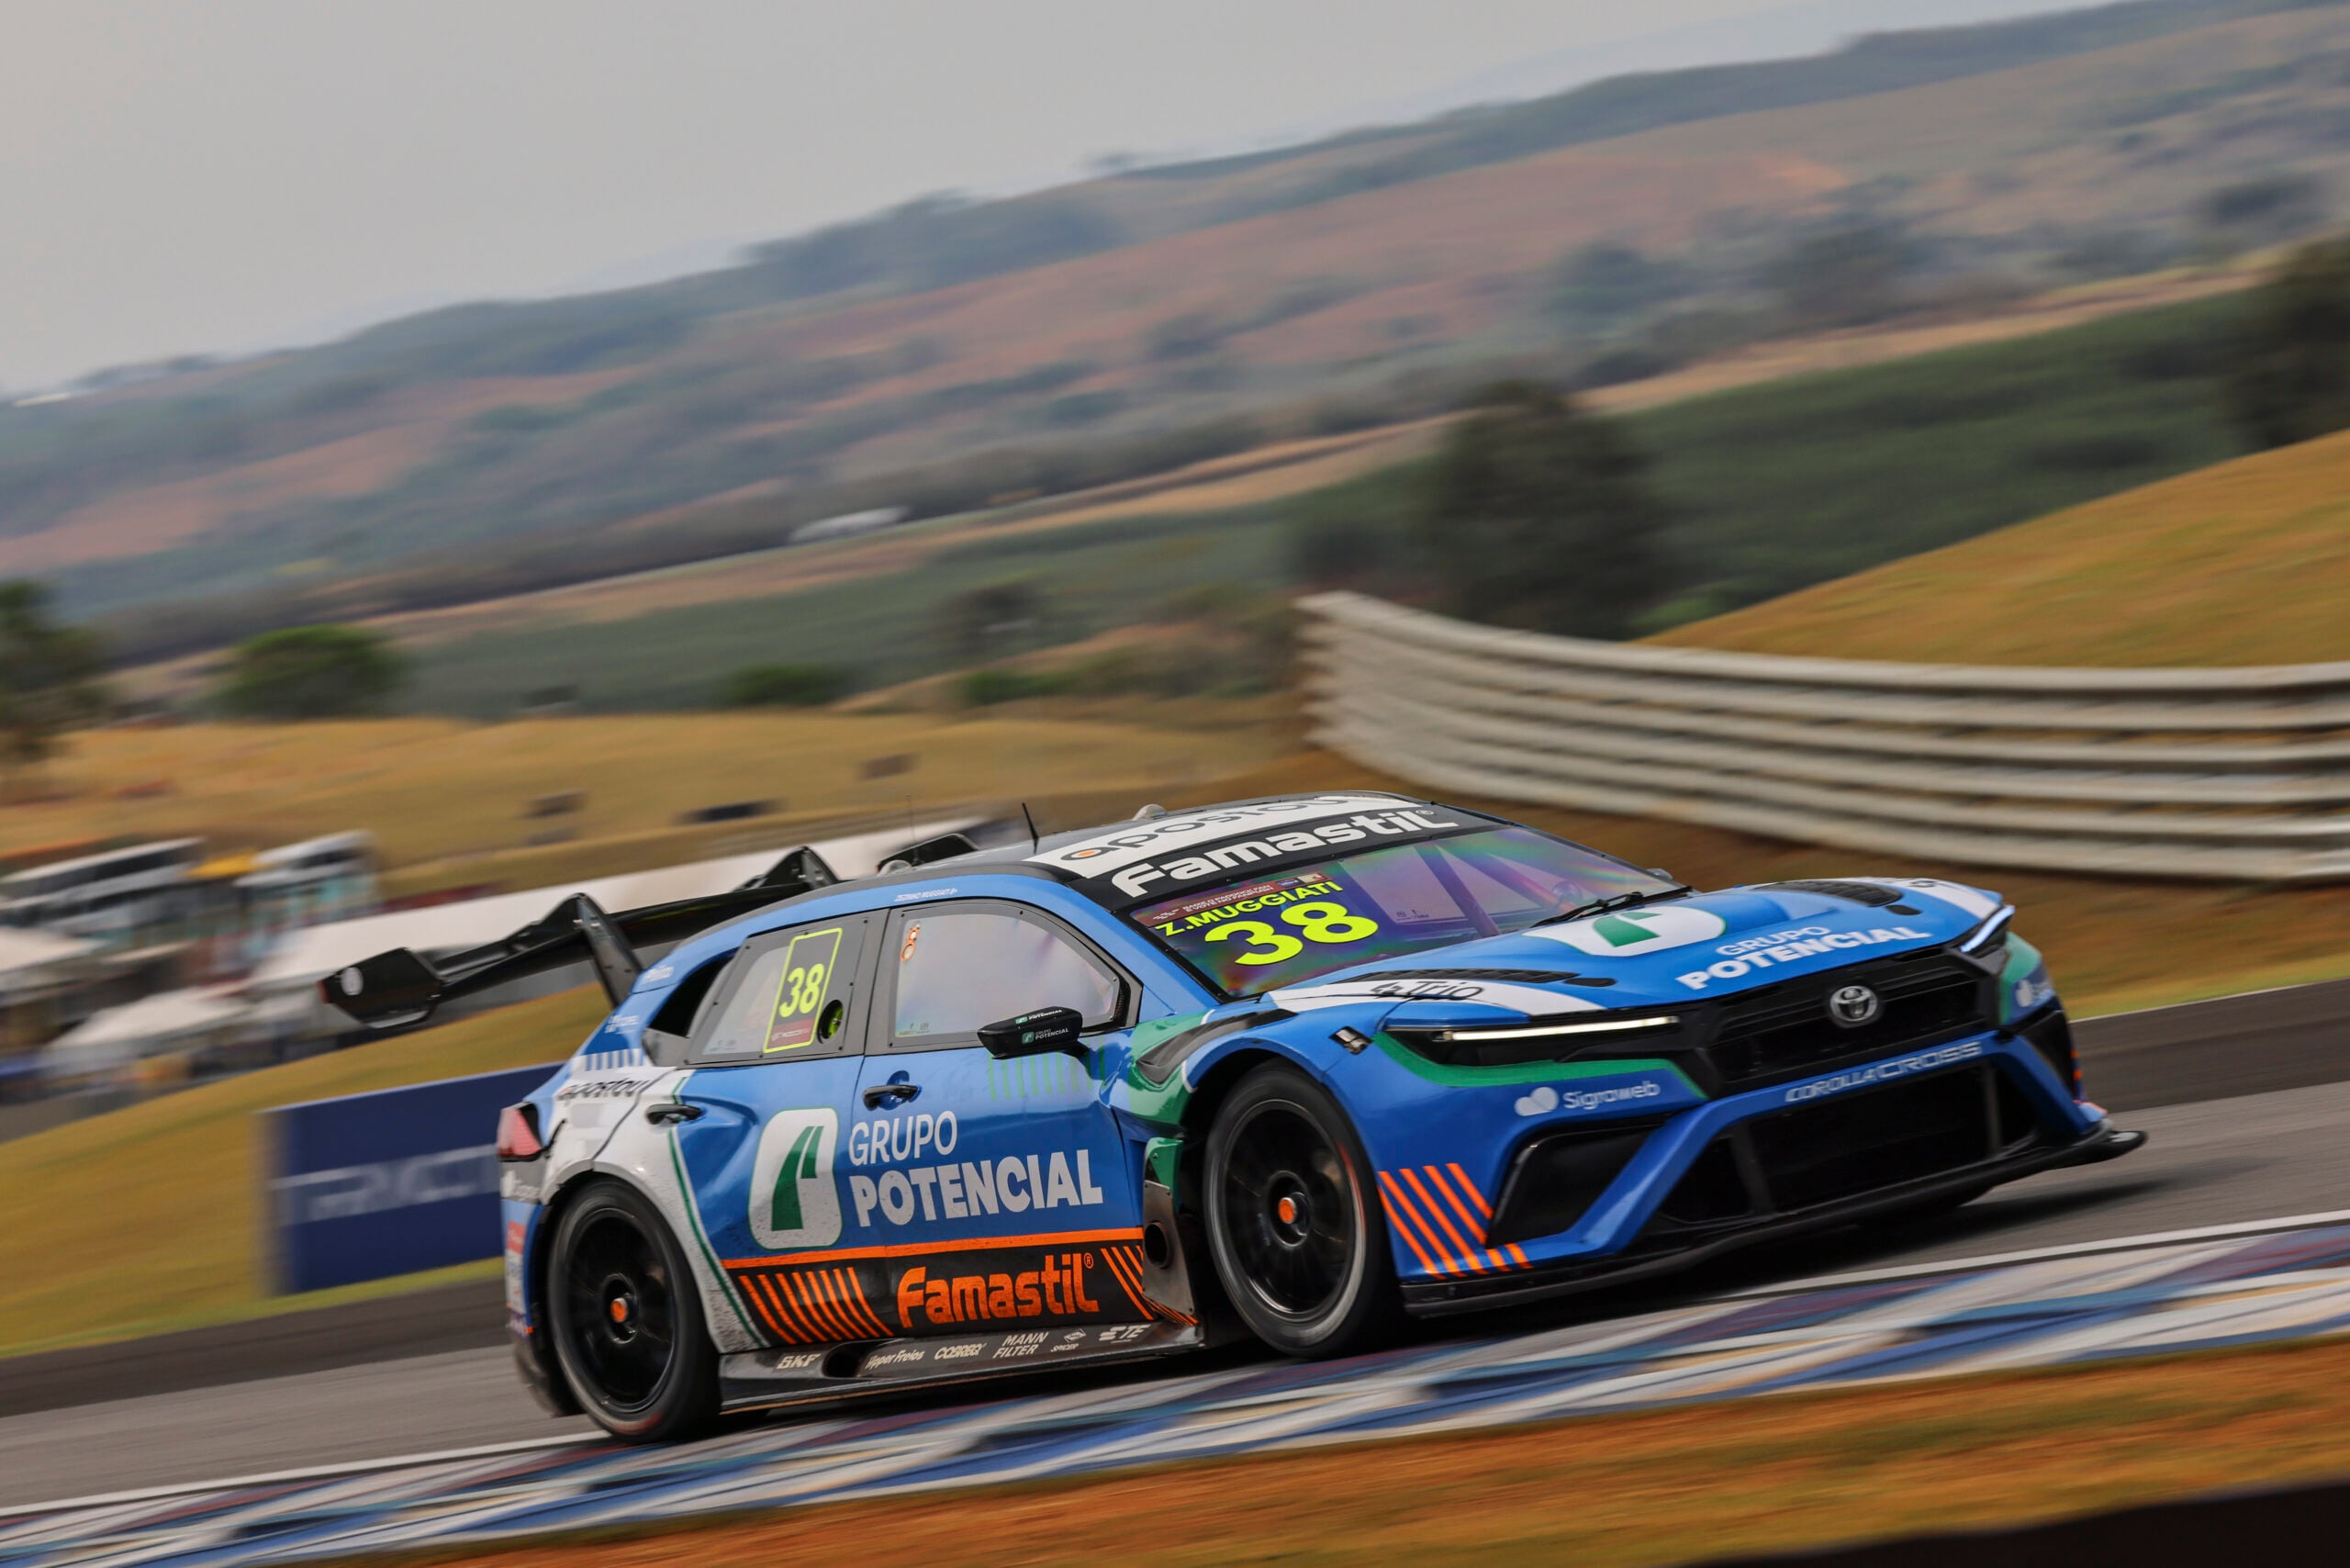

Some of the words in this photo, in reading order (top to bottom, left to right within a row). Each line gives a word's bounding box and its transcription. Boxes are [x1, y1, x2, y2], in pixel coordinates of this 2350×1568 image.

[1155, 881, 1344, 936] Z.MUGGIATI
[1204, 902, 1379, 966] 38
[1716, 926, 1831, 956] GRUPO
[1675, 926, 1933, 991] POTENCIAL
[779, 964, 824, 1018] 38
[1035, 1028, 1069, 1040] POTENCIAL
[1875, 1041, 1983, 1079] CROSS
[1563, 1081, 1662, 1110] Sigraweb
[849, 1111, 957, 1166] GRUPO
[849, 1149, 1103, 1227] POTENCIAL
[992, 1344, 1039, 1359] FILTER
[1002, 1332, 1049, 1347] MANN
[777, 1353, 822, 1369] SKF
